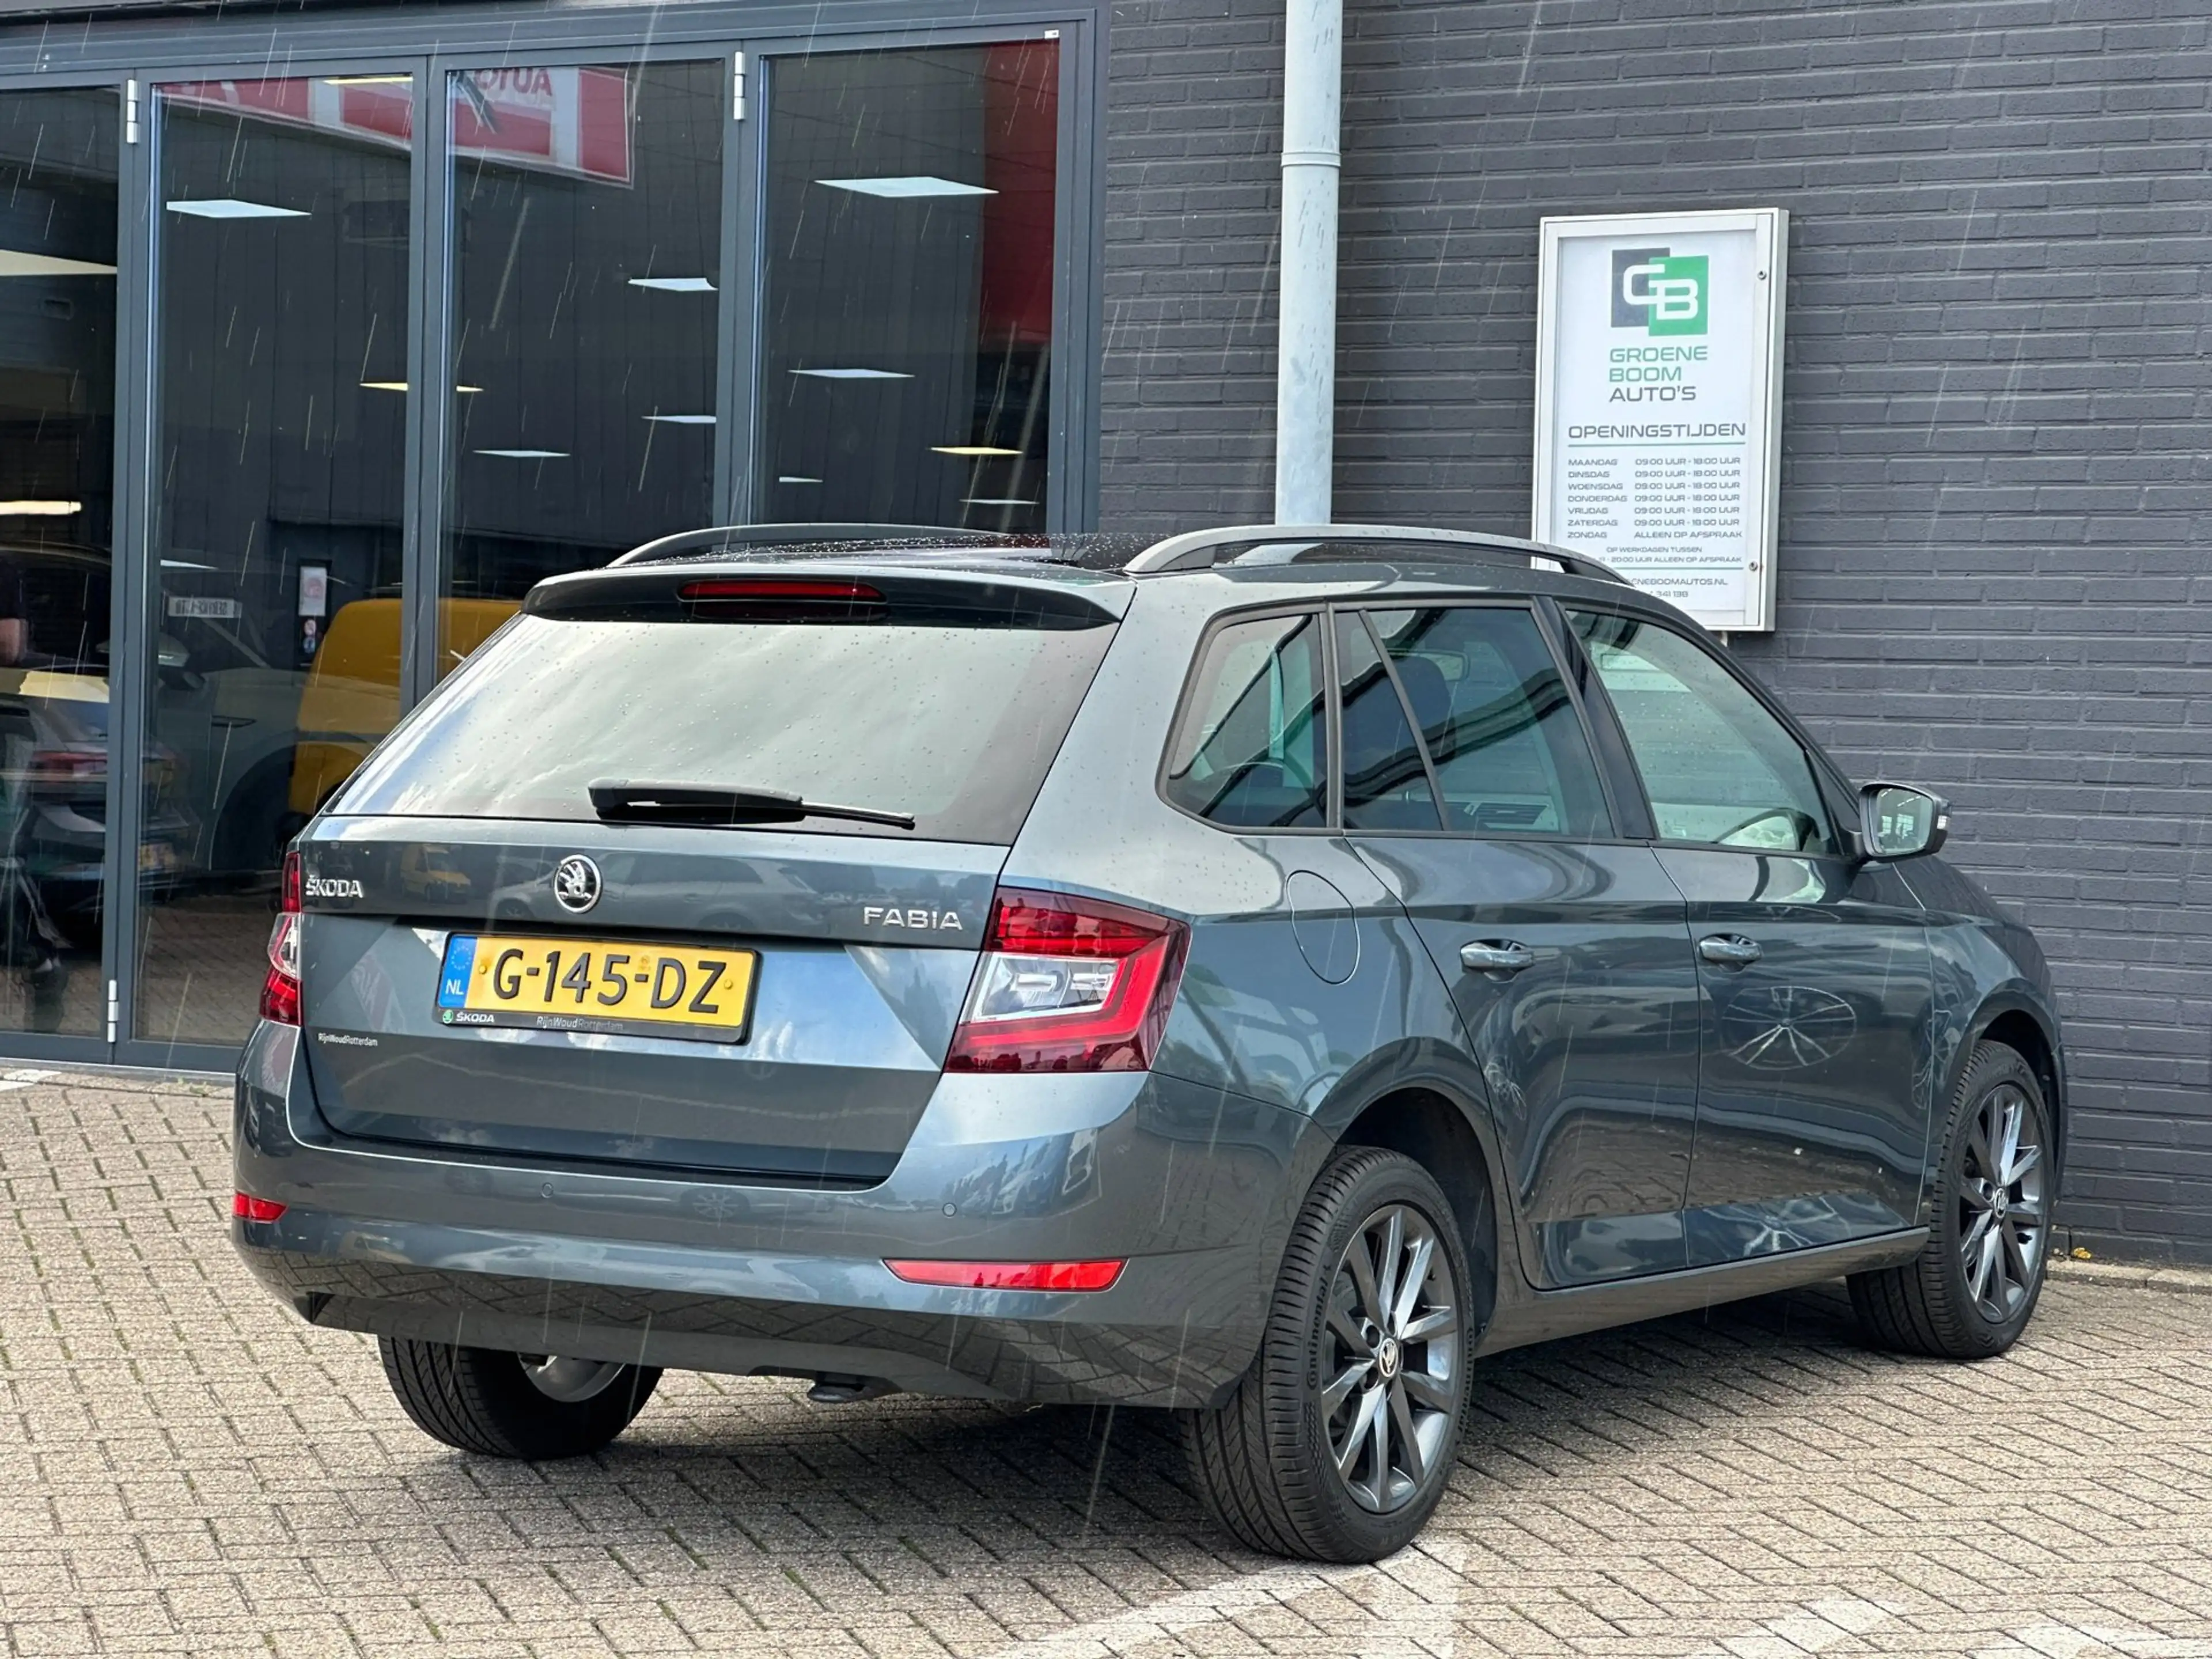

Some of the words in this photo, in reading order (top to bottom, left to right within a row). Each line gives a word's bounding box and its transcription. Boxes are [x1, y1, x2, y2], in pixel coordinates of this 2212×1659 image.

[1609, 346, 1708, 363] GROENE
[1609, 366, 1682, 382] BOOM
[1609, 385, 1696, 403] AUTO'S
[1568, 423, 1746, 440] OPENINGSTIJDEN
[305, 874, 364, 899] ŠKODA
[863, 906, 964, 930] FABIA
[445, 979, 464, 995] NL
[493, 948, 727, 1014] G-145-DZ
[456, 1011, 495, 1024] ŠKODA
[1305, 1275, 1330, 1392] Continental
